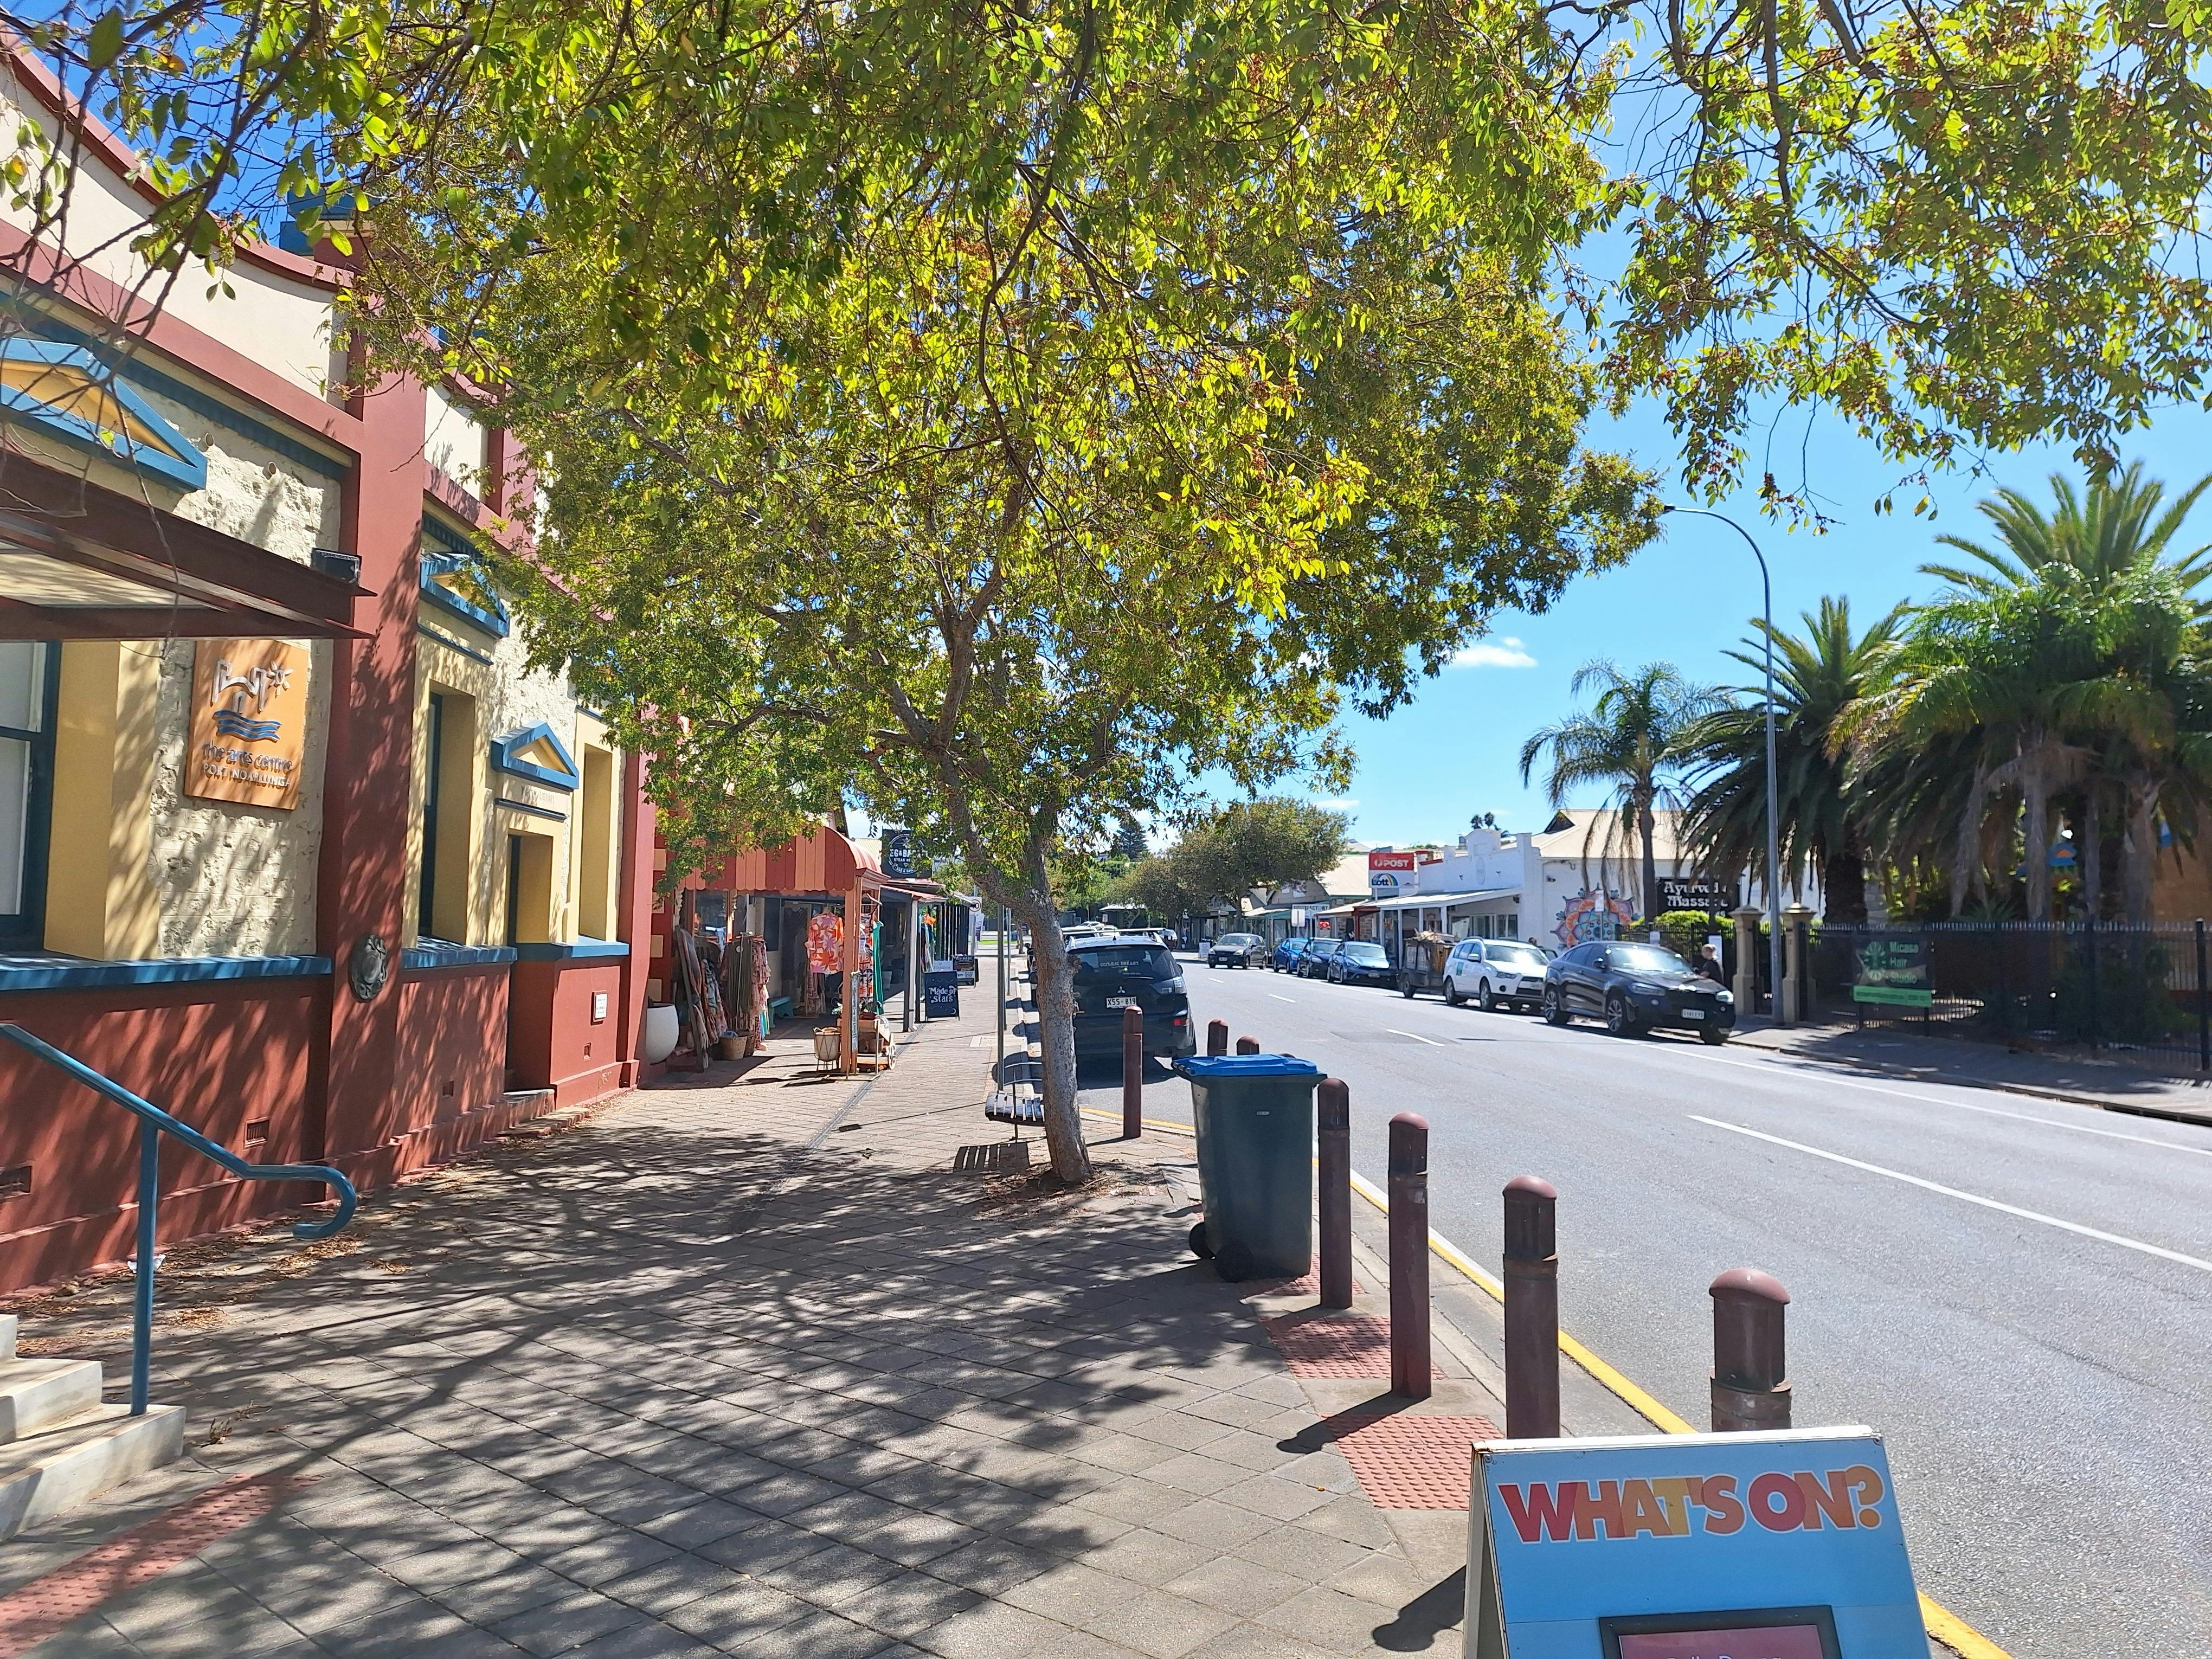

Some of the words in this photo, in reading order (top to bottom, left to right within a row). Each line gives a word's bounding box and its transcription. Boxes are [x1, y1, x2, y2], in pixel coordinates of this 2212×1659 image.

[202, 740, 226, 760] the
[227, 749, 253, 764] arts
[255, 754, 293, 774] centre
[203, 763, 229, 777] PORT
[232, 768, 291, 787] NOARLUNGA
[1383, 859, 1409, 867] POST
[1371, 878, 1390, 886] Lott
[928, 987, 948, 995] Made
[948, 985, 957, 995] of
[1497, 1472, 1746, 1545] WHAT'S
[1747, 1464, 1885, 1533] ON?
